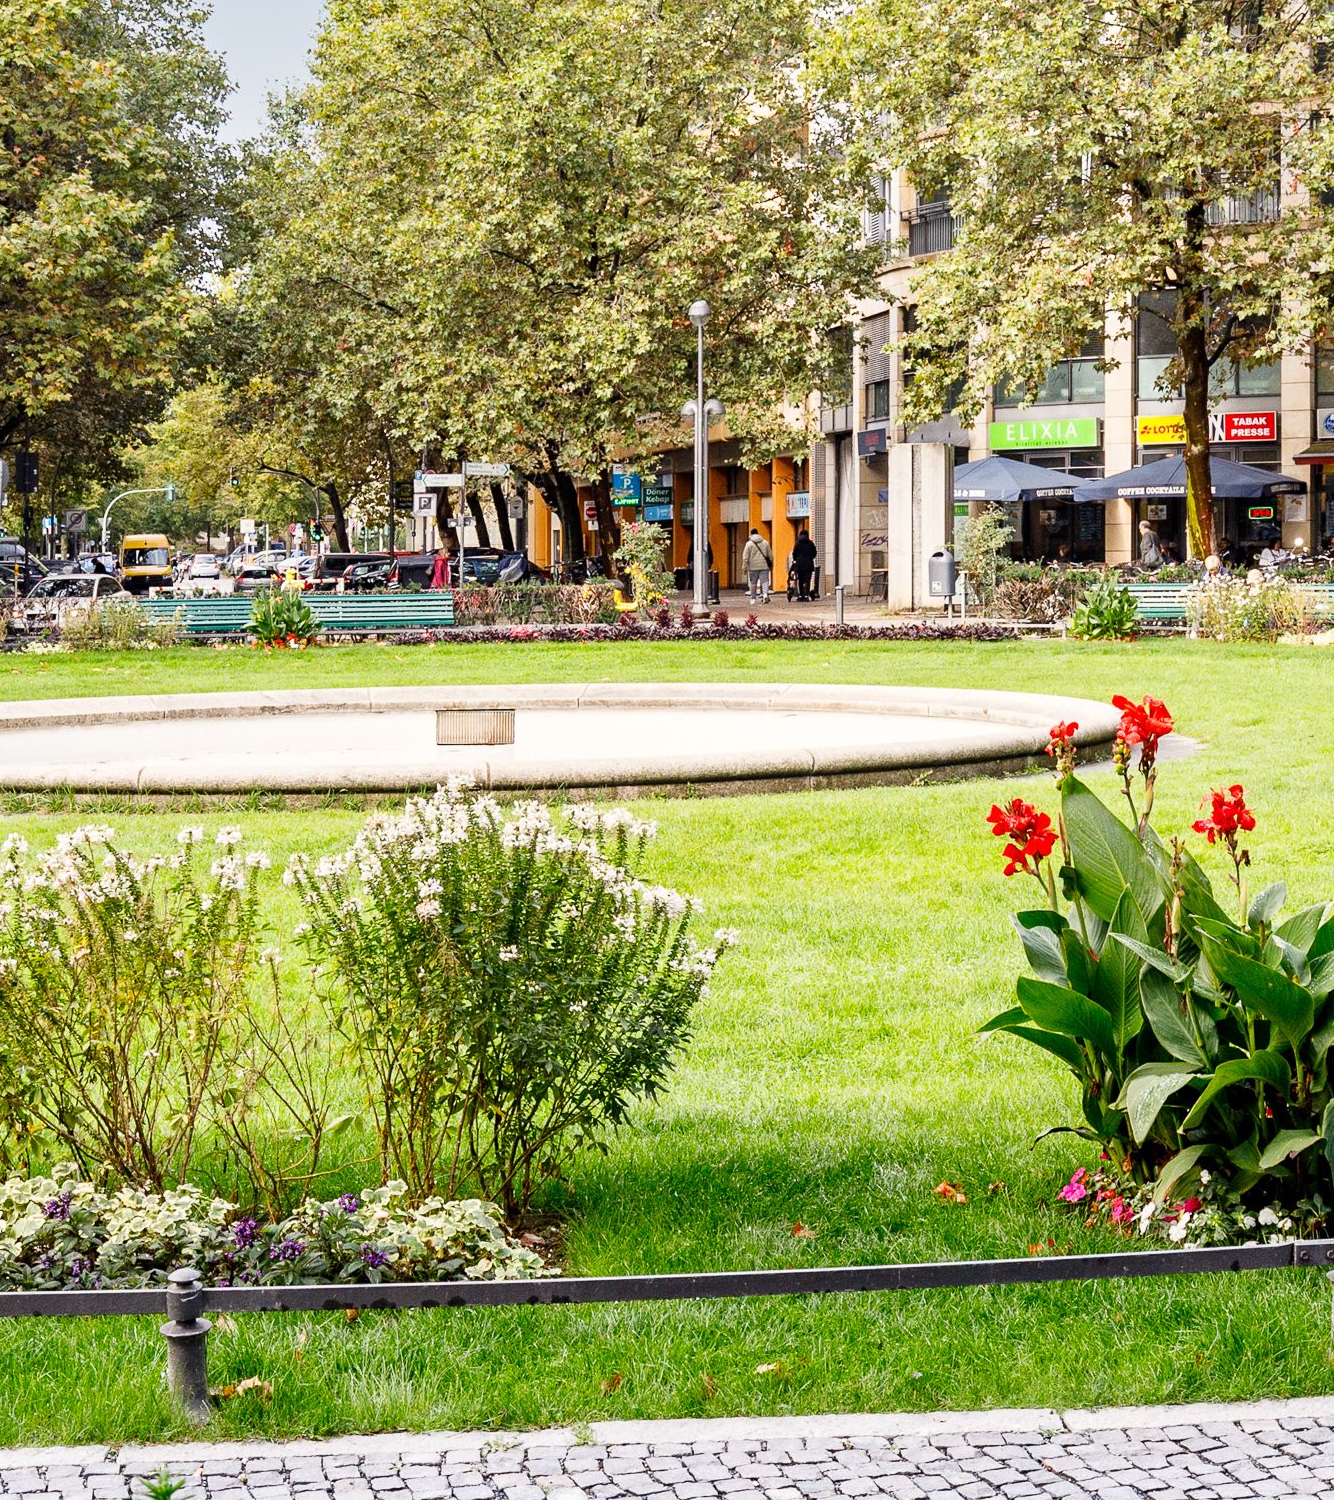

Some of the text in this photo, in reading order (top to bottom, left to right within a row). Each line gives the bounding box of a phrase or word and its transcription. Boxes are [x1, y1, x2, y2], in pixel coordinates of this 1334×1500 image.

[1232, 416, 1267, 426] TABAK
[1007, 421, 1078, 441] ELIXIA
[1231, 428, 1270, 437] PRESSE
[646, 488, 670, 496] Döner
[646, 496, 670, 504] Kebap
